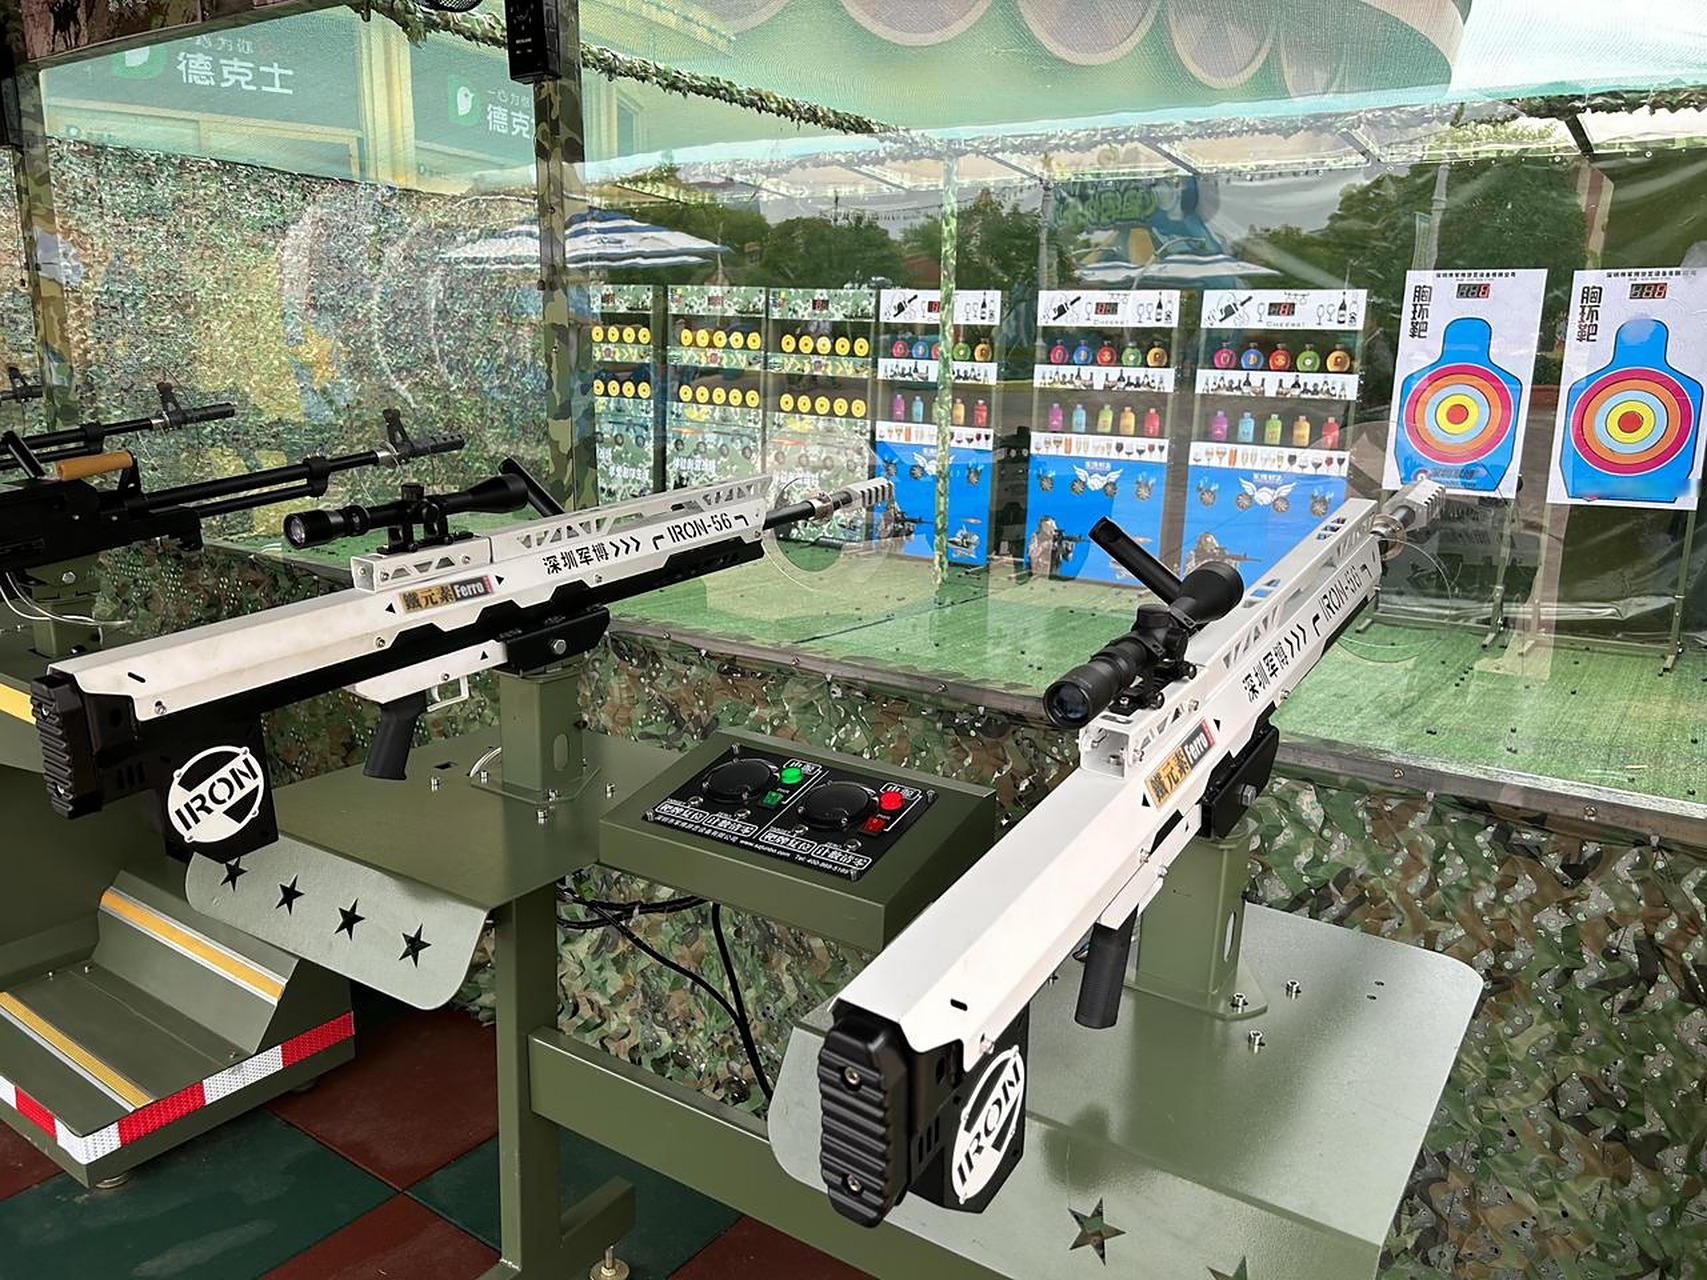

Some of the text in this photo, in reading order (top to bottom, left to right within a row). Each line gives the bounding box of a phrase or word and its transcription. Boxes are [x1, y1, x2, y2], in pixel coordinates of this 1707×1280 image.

[176, 51, 294, 95] 德克士
[486, 103, 534, 140] 德克
[1409, 284, 1433, 339] 胸环靶
[1576, 285, 1603, 343] 胸环靶
[665, 513, 733, 545] IRON-56
[541, 541, 611, 576] 深圳军博
[453, 582, 485, 598] Ferro
[1319, 564, 1364, 623] IRON-56
[1241, 641, 1291, 704] 深圳军博
[1183, 731, 1210, 764] Ferro
[174, 757, 259, 832] IRON
[956, 1060, 1022, 1188] IRON
